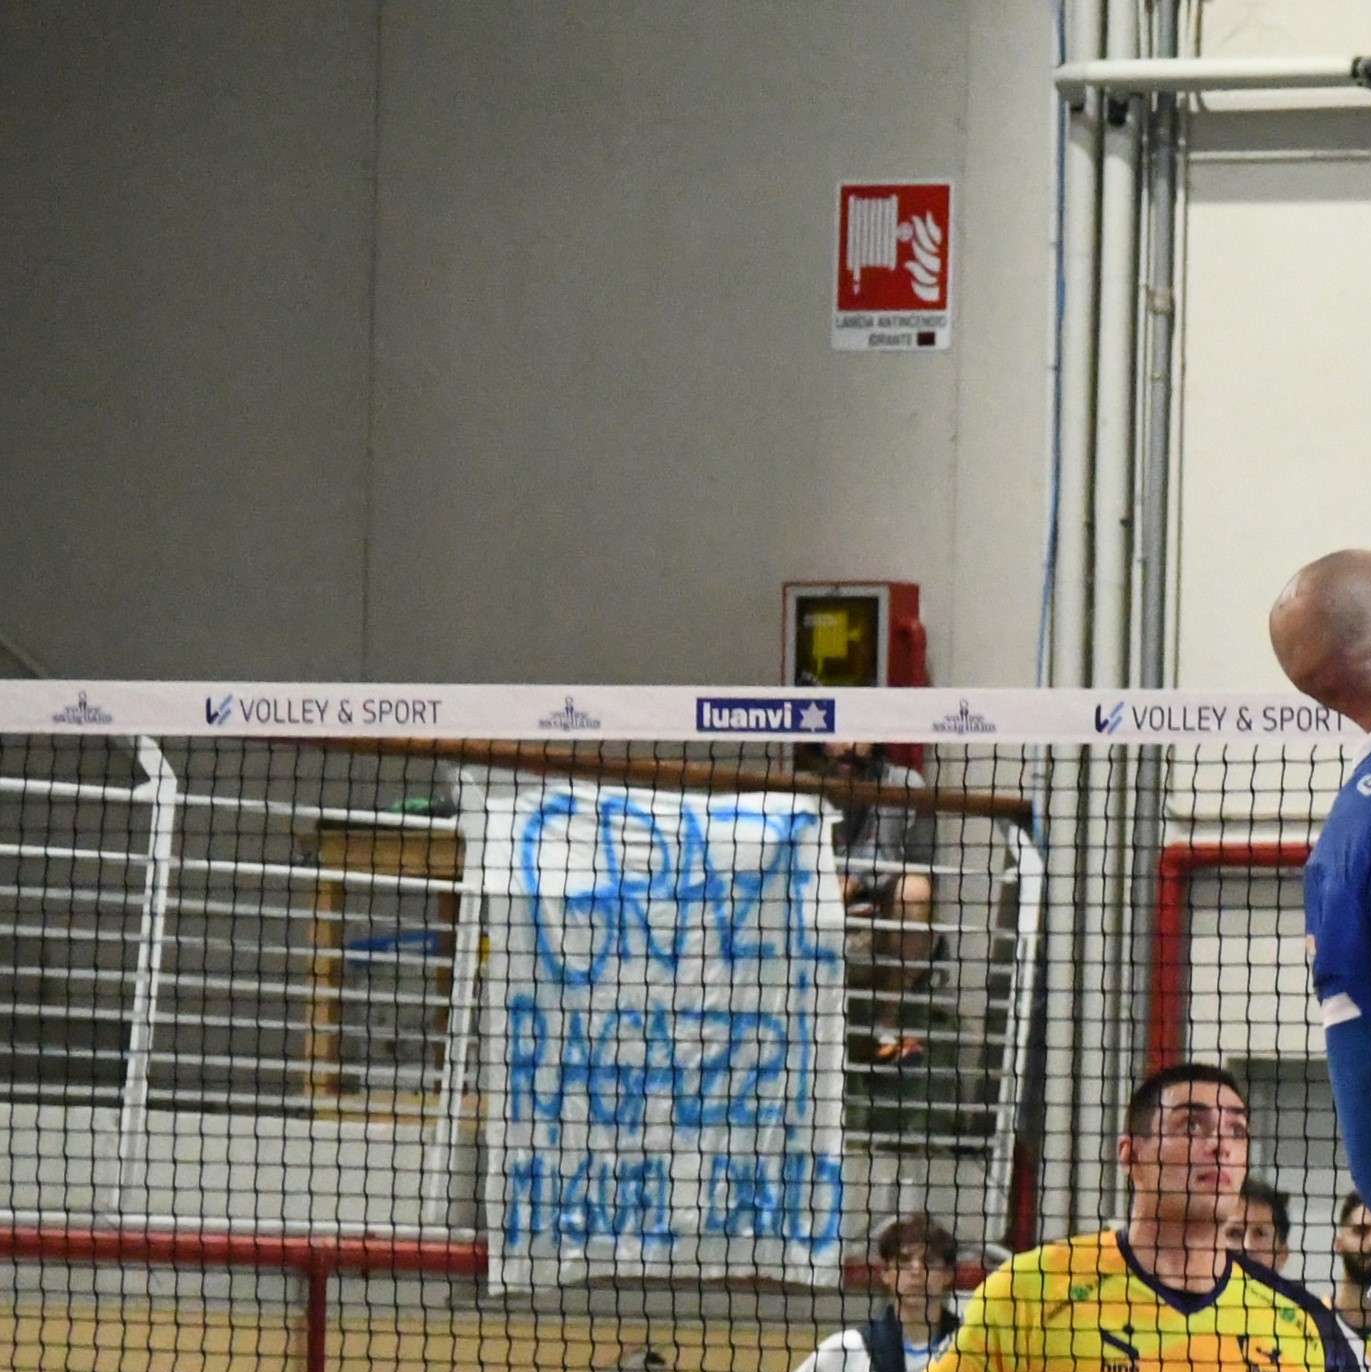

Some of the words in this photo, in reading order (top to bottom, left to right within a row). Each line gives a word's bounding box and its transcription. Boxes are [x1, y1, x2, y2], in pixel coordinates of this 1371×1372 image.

[240, 699, 331, 725] VOLLEY
[338, 699, 354, 725] &
[362, 700, 443, 726] SPORT
[1132, 706, 1228, 732] VOLLEY
[1236, 707, 1252, 732] &
[1262, 707, 1346, 733] SPORT
